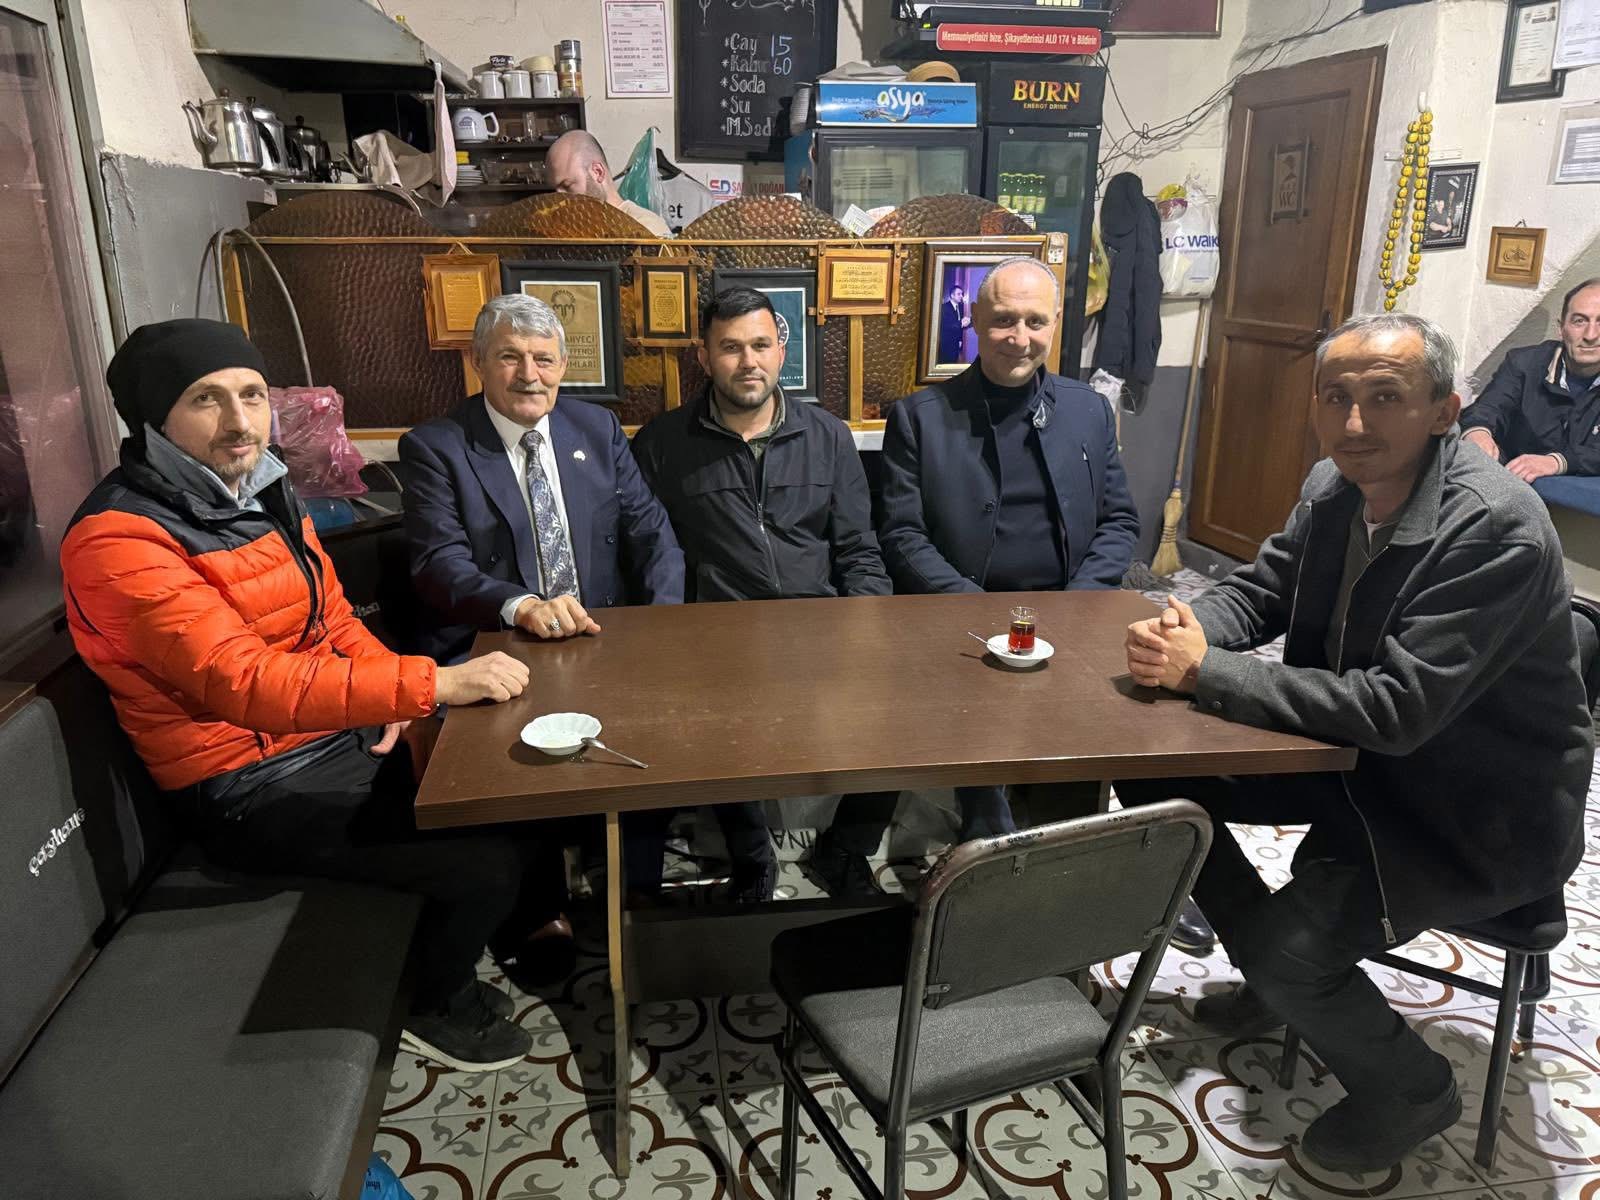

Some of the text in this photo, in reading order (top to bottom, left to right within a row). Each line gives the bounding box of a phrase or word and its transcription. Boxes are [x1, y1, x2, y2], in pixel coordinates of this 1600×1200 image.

[730, 32, 793, 58] Çay 15
[1058, 34, 1070, 45] 174
[773, 57, 792, 76] 60
[729, 74, 766, 94] Soda
[1012, 79, 1081, 104] BURN
[730, 95, 751, 115] Su
[877, 86, 925, 118] asya
[1049, 103, 1068, 111] DRINK
[726, 116, 772, 137] M.Sod
[668, 202, 684, 219] et
[1165, 235, 1185, 250] LC
[565, 335, 595, 344] AHVECİ
